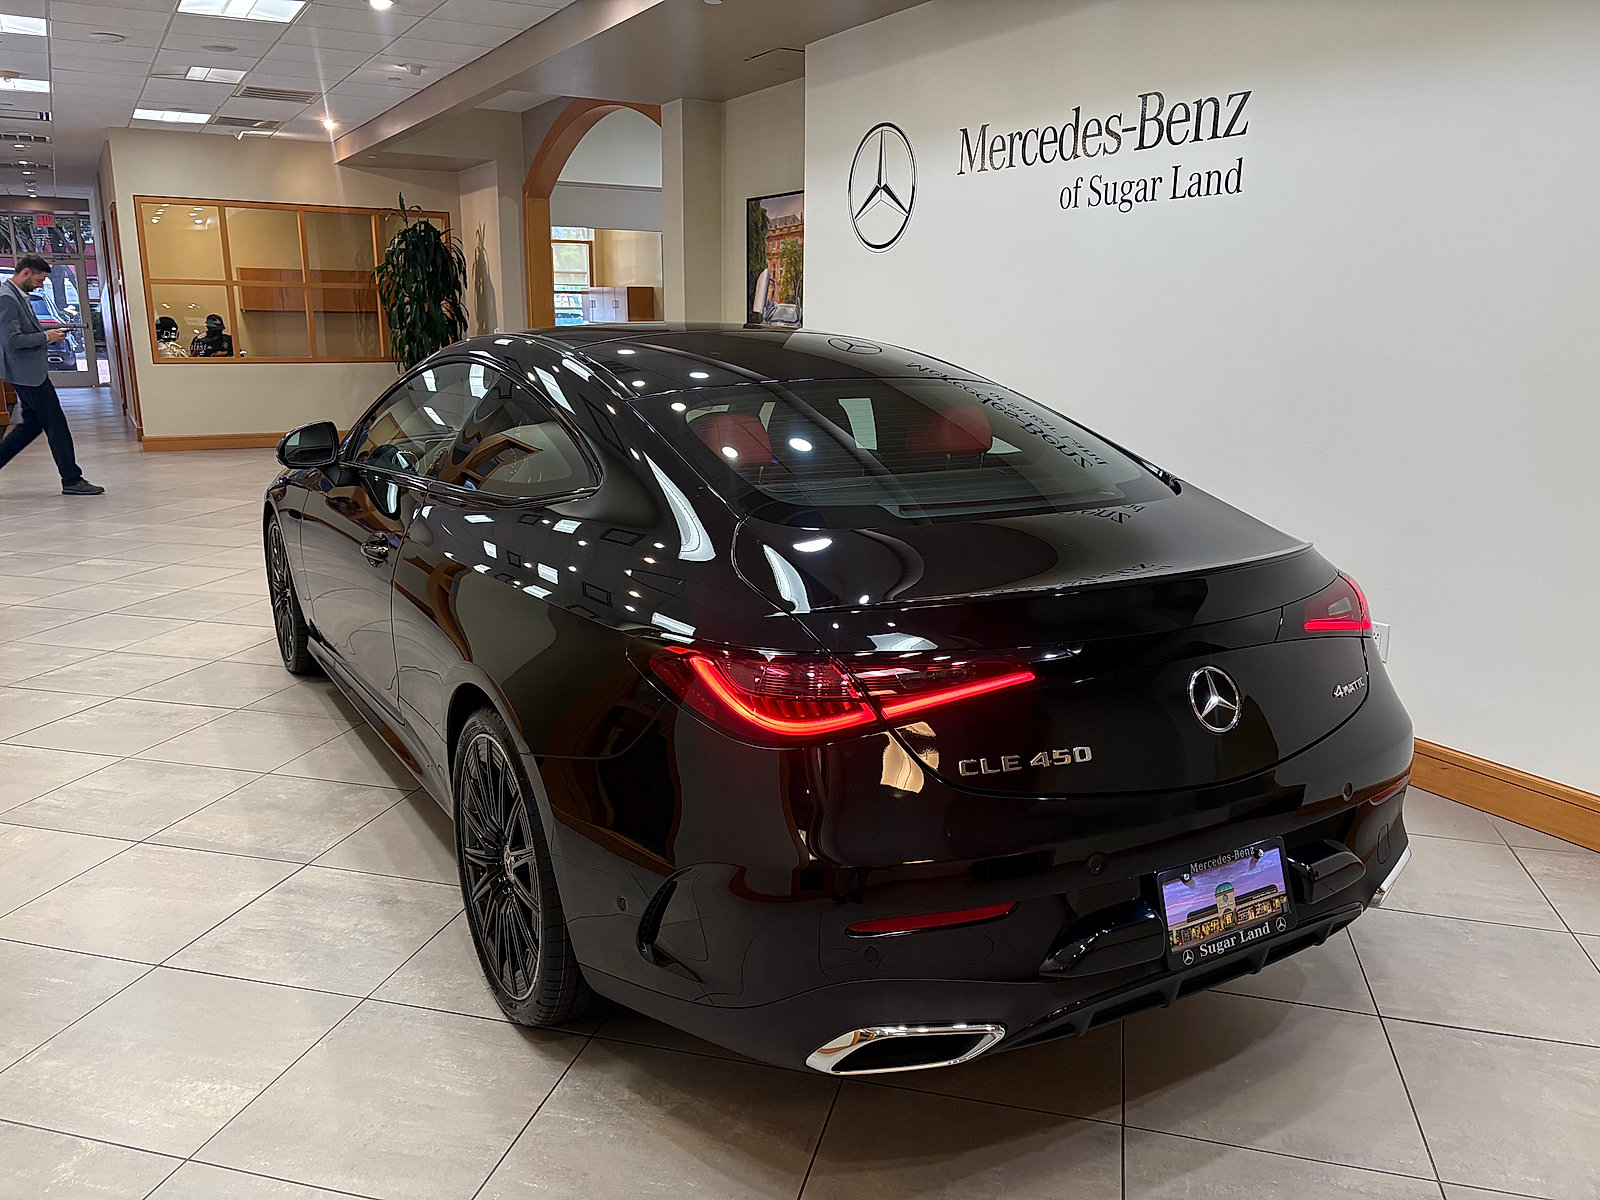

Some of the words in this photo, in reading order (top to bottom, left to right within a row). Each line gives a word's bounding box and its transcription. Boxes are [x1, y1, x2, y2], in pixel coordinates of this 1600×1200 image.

[957, 90, 1252, 176] Mercedes-Benz
[1059, 176, 1084, 209] of
[1087, 174, 1163, 213] Sugar
[1170, 157, 1243, 200] Land
[37, 215, 52, 226] EXIT
[958, 754, 1022, 777] CLE
[1030, 746, 1092, 768] 450
[1190, 846, 1255, 874] Mercedes-Benz
[1199, 935, 1237, 957] Sugar
[1239, 922, 1271, 943] Land
